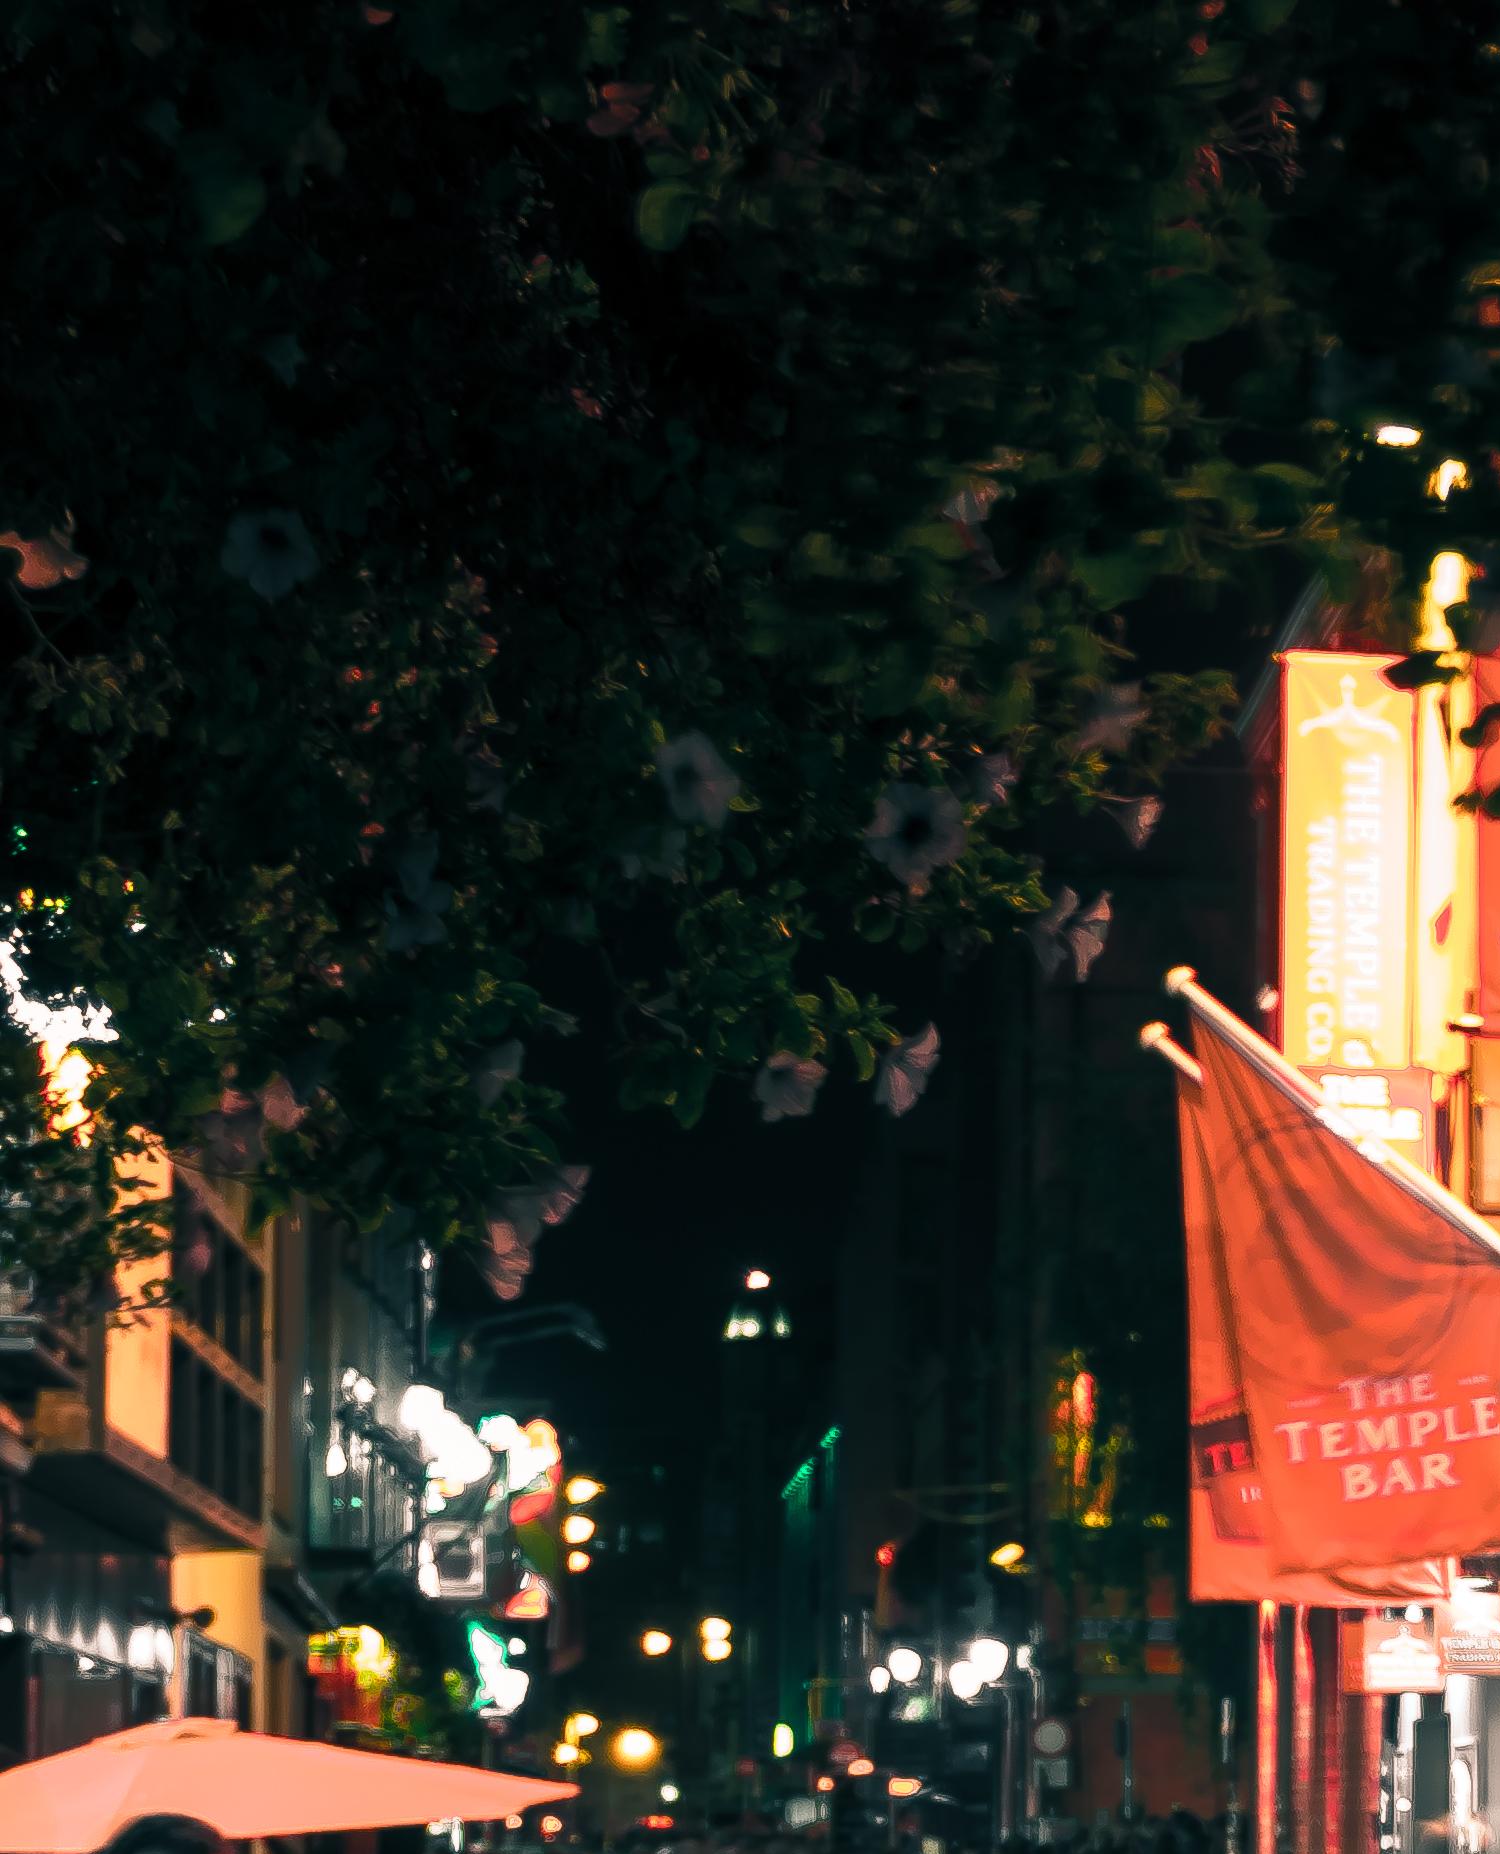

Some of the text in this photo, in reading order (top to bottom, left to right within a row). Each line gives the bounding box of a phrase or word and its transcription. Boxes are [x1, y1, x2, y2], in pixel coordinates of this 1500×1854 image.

[1338, 1372, 1437, 1411] THE
[1274, 1396, 1500, 1464] TEMPLE
[1340, 1452, 1459, 1502] BAR
